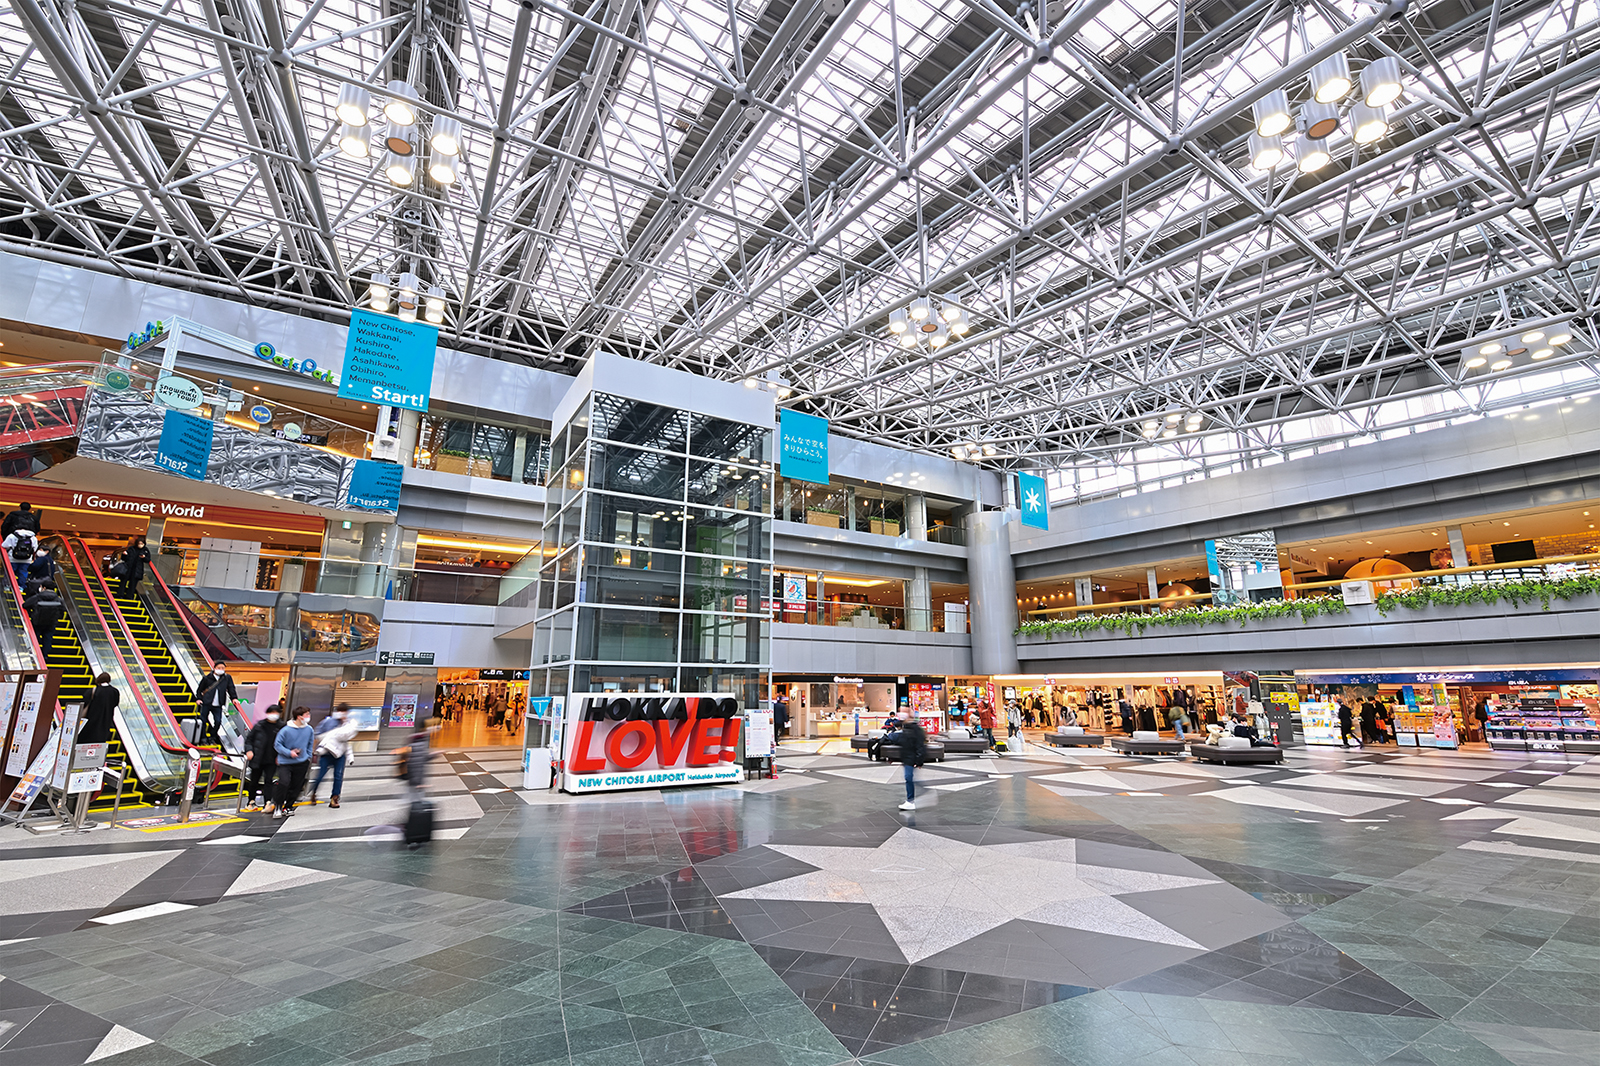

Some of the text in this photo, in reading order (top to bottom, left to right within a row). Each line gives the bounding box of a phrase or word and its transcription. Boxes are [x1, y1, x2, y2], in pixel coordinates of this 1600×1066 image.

[358, 318, 379, 328] New
[371, 386, 424, 407] Start!
[86, 495, 205, 518] Gourmet World
[578, 697, 738, 721] HOKKAIDO
[568, 718, 742, 772] LOVE!
[578, 778, 603, 788] NEW
[605, 775, 645, 786] CHITOSE
[646, 773, 686, 783] AIRPORT
